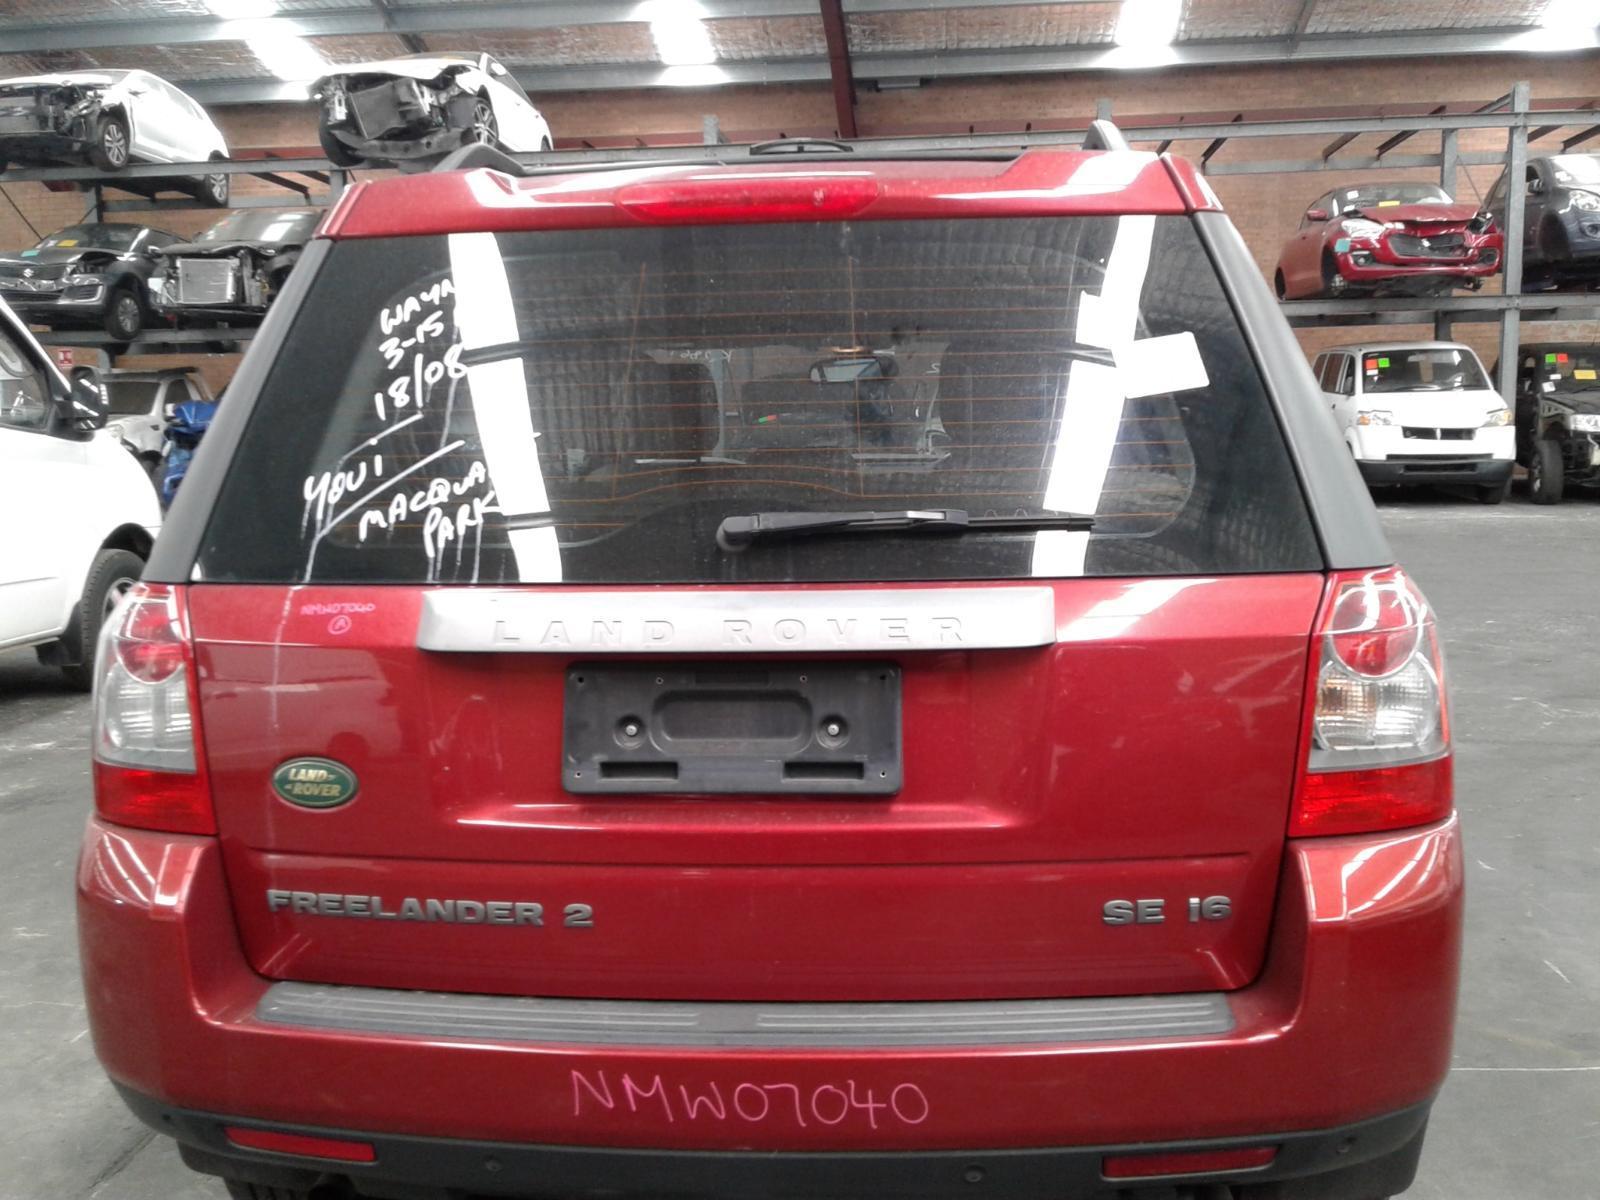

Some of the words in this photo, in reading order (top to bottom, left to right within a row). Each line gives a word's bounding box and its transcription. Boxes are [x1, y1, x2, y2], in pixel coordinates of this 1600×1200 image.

[424, 490, 502, 558] PARK
[494, 618, 675, 647] LAND
[722, 615, 967, 645] ROVER
[288, 768, 329, 782] LAND
[291, 783, 341, 797] ROVER
[267, 889, 544, 926] FREELANDER
[563, 903, 594, 928] 2
[1102, 899, 1166, 925] SE
[571, 1069, 929, 1129] NMW07040
